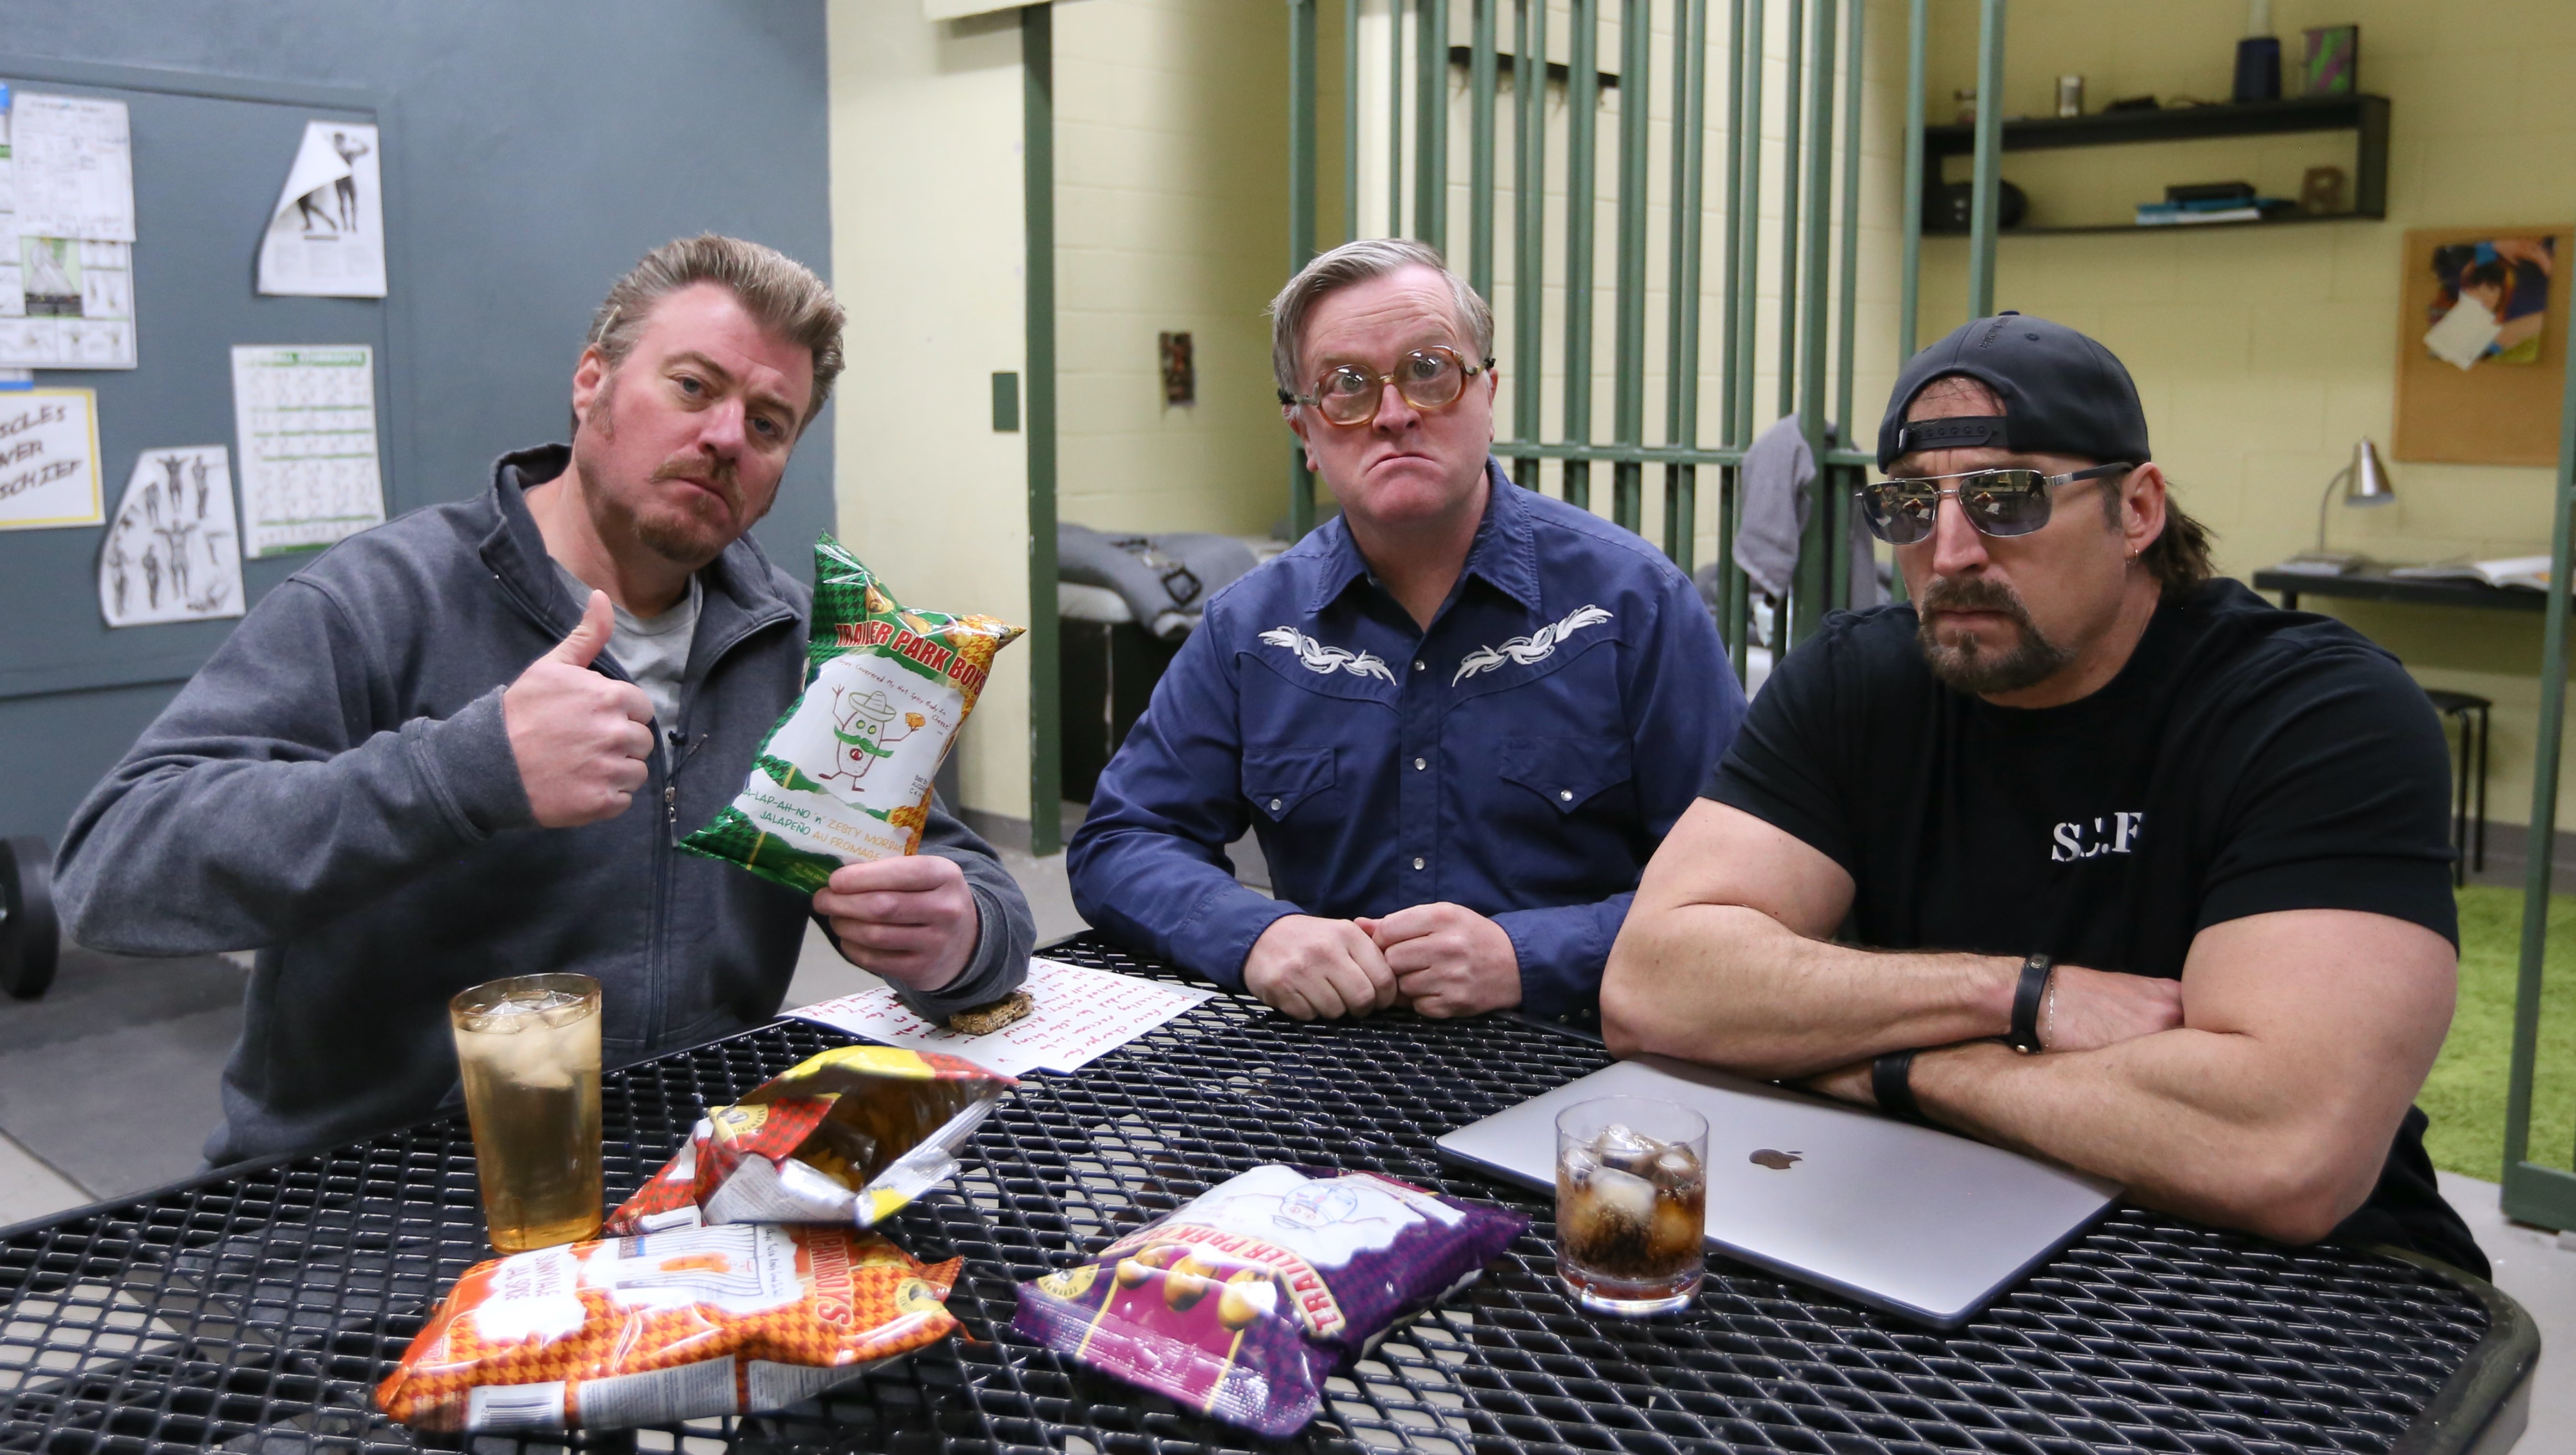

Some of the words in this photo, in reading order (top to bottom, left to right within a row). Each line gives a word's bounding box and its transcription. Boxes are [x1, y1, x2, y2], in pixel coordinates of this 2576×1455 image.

[835, 620, 895, 647] TRAILER
[890, 629, 953, 673] PARK
[946, 656, 988, 697] BOYS
[897, 685, 909, 695] Hot
[911, 692, 924, 703] Spicy
[925, 701, 938, 712] Body
[743, 788, 811, 819] A-LAP-AH-NO
[827, 819, 863, 837] ZESTY
[759, 810, 811, 836] JALAPEÑO
[812, 830, 829, 842] AU
[830, 836, 882, 861] FROMAGE
[1175, 1226, 1250, 1253] PARK
[535, 1252, 561, 1297] SUNNYVALE
[814, 1267, 854, 1326] BOYS
[1242, 1245, 1339, 1332] TRAILER
